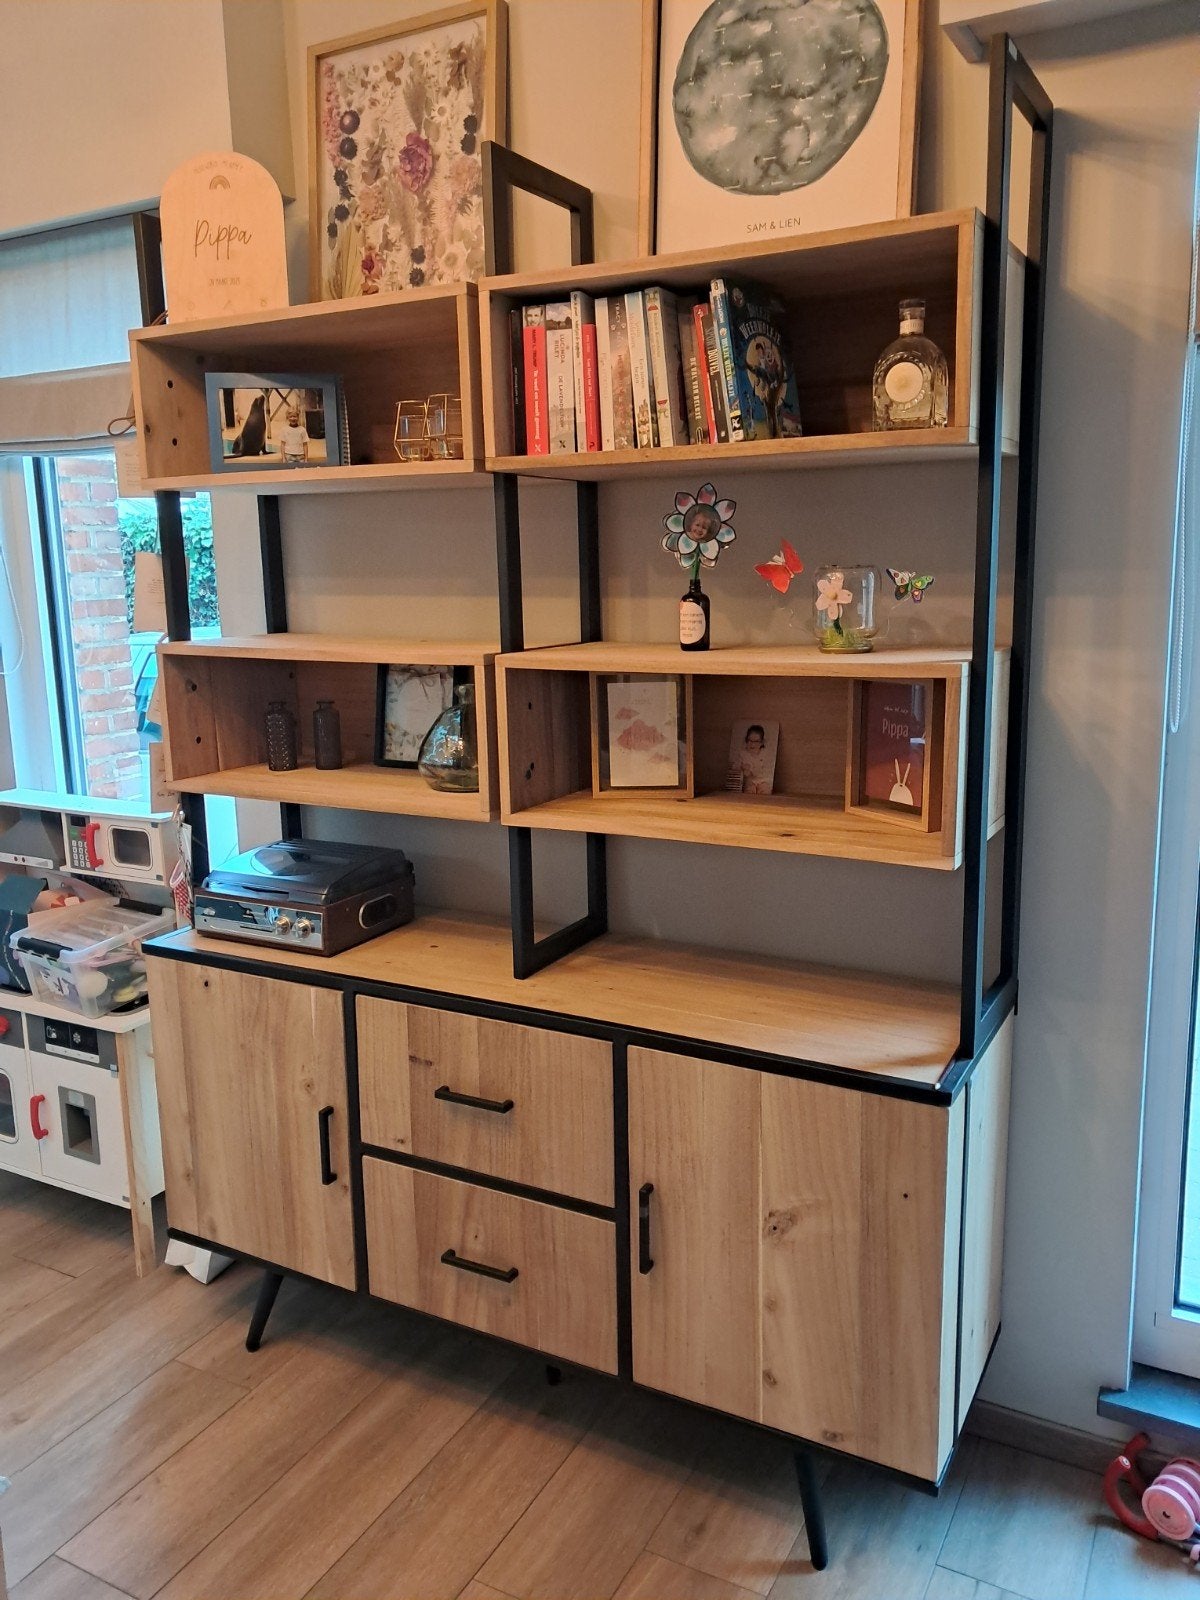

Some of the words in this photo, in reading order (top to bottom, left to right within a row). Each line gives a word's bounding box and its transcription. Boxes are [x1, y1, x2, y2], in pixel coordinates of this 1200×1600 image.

[746, 222, 767, 234] SAM
[769, 220, 777, 230] &
[779, 217, 801, 229] LIEN
[194, 219, 252, 261] Pippa
[882, 718, 909, 739] Pippa
